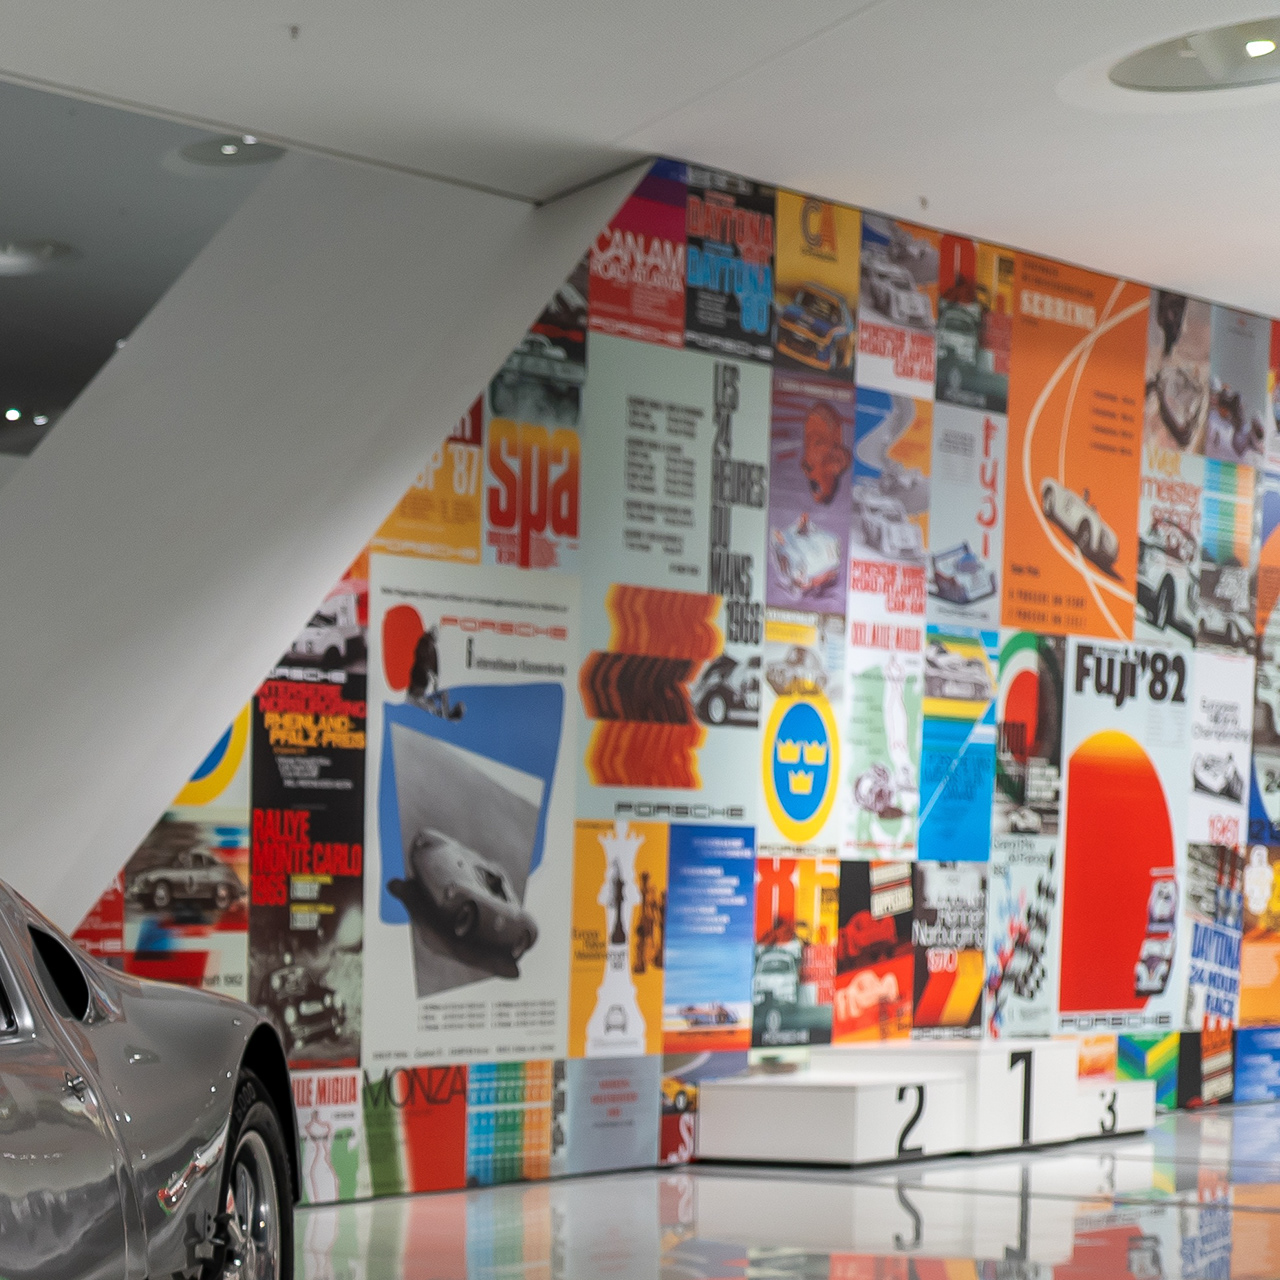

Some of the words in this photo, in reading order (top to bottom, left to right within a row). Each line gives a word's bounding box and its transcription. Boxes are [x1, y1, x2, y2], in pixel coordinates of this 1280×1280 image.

[441, 616, 567, 640] PORSCHE
[252, 808, 311, 843] RALLYE
[615, 802, 745, 818] PORSCHE
[252, 842, 311, 875] MONTE
[313, 843, 362, 876] CARLO
[1060, 1014, 1172, 1029] PORSCHE
[315, 1076, 357, 1105] MIGLIA
[362, 1064, 468, 1109] MONZA
[1008, 1050, 1034, 1146] 1
[896, 1084, 927, 1158] 2
[1100, 1089, 1118, 1136] 3
